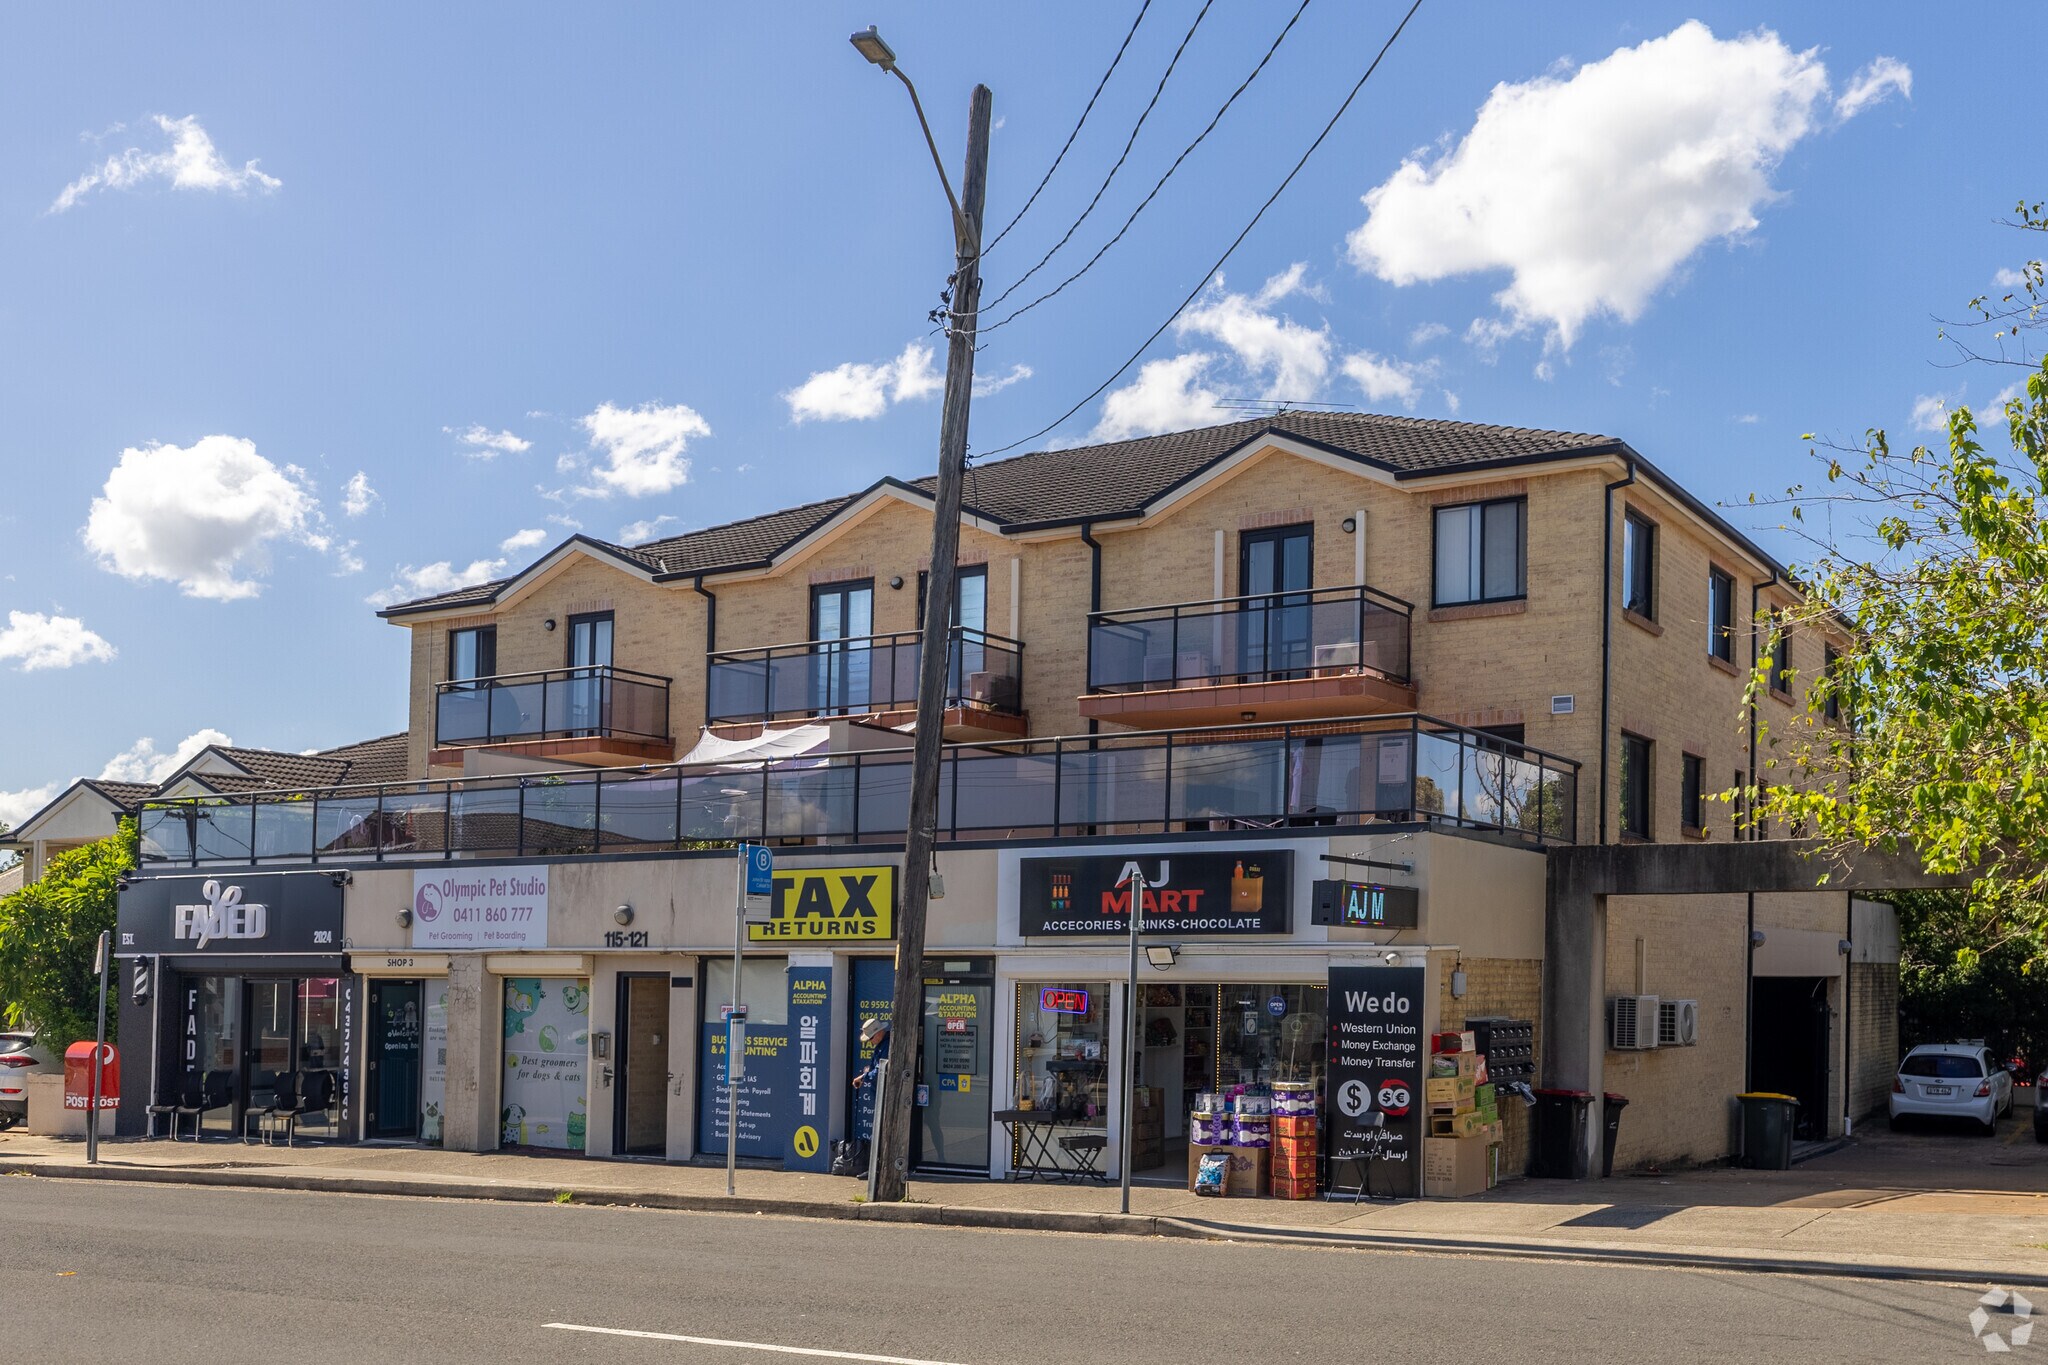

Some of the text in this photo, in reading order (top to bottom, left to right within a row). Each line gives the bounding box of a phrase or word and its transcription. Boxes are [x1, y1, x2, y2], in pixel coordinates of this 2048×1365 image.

[760, 854, 766, 866] B
[1114, 860, 1170, 888] AJ
[442, 876, 546, 902] Olympic Pet Studio
[770, 875, 878, 918] TAX
[1102, 890, 1204, 914] MART
[453, 907, 533, 922] 0411 860 777
[175, 904, 267, 940] FADED
[762, 920, 876, 936] RETURNS
[1042, 920, 1122, 930] ACCECORIES
[1180, 918, 1261, 930] CHOCOLATE
[313, 930, 332, 944] 2024
[428, 932, 473, 941] Pet Grooming
[484, 931, 526, 940] Pet Boarding
[604, 931, 648, 948] 115-121
[387, 958, 414, 967] SHOP 3
[793, 980, 826, 990] ALPHA
[860, 1000, 870, 1008] 02
[870, 1001, 889, 1009] 9592
[940, 994, 976, 1004] ALPHA
[1044, 991, 1086, 1012] OPEN
[860, 1012, 878, 1020] 0424
[948, 1022, 965, 1030] OPEN
[1340, 1022, 1416, 1034] Western Union
[753, 1036, 788, 1046] SERVICE
[1341, 1040, 1416, 1053] Money Exchange
[711, 1046, 717, 1054] &
[522, 1056, 578, 1068] Best groomers
[798, 1016, 818, 1116] 알파회계
[1341, 1056, 1416, 1068] Money Transfer
[517, 1069, 530, 1080] for
[532, 1070, 550, 1080] dogs
[554, 1072, 560, 1080] &
[941, 1078, 956, 1086] CPA
[752, 1088, 772, 1096] Payroll
[66, 1096, 88, 1108] POST
[741, 1110, 771, 1118] Statements
[738, 1121, 756, 1129] Set-up
[738, 1132, 761, 1142] Advisory
